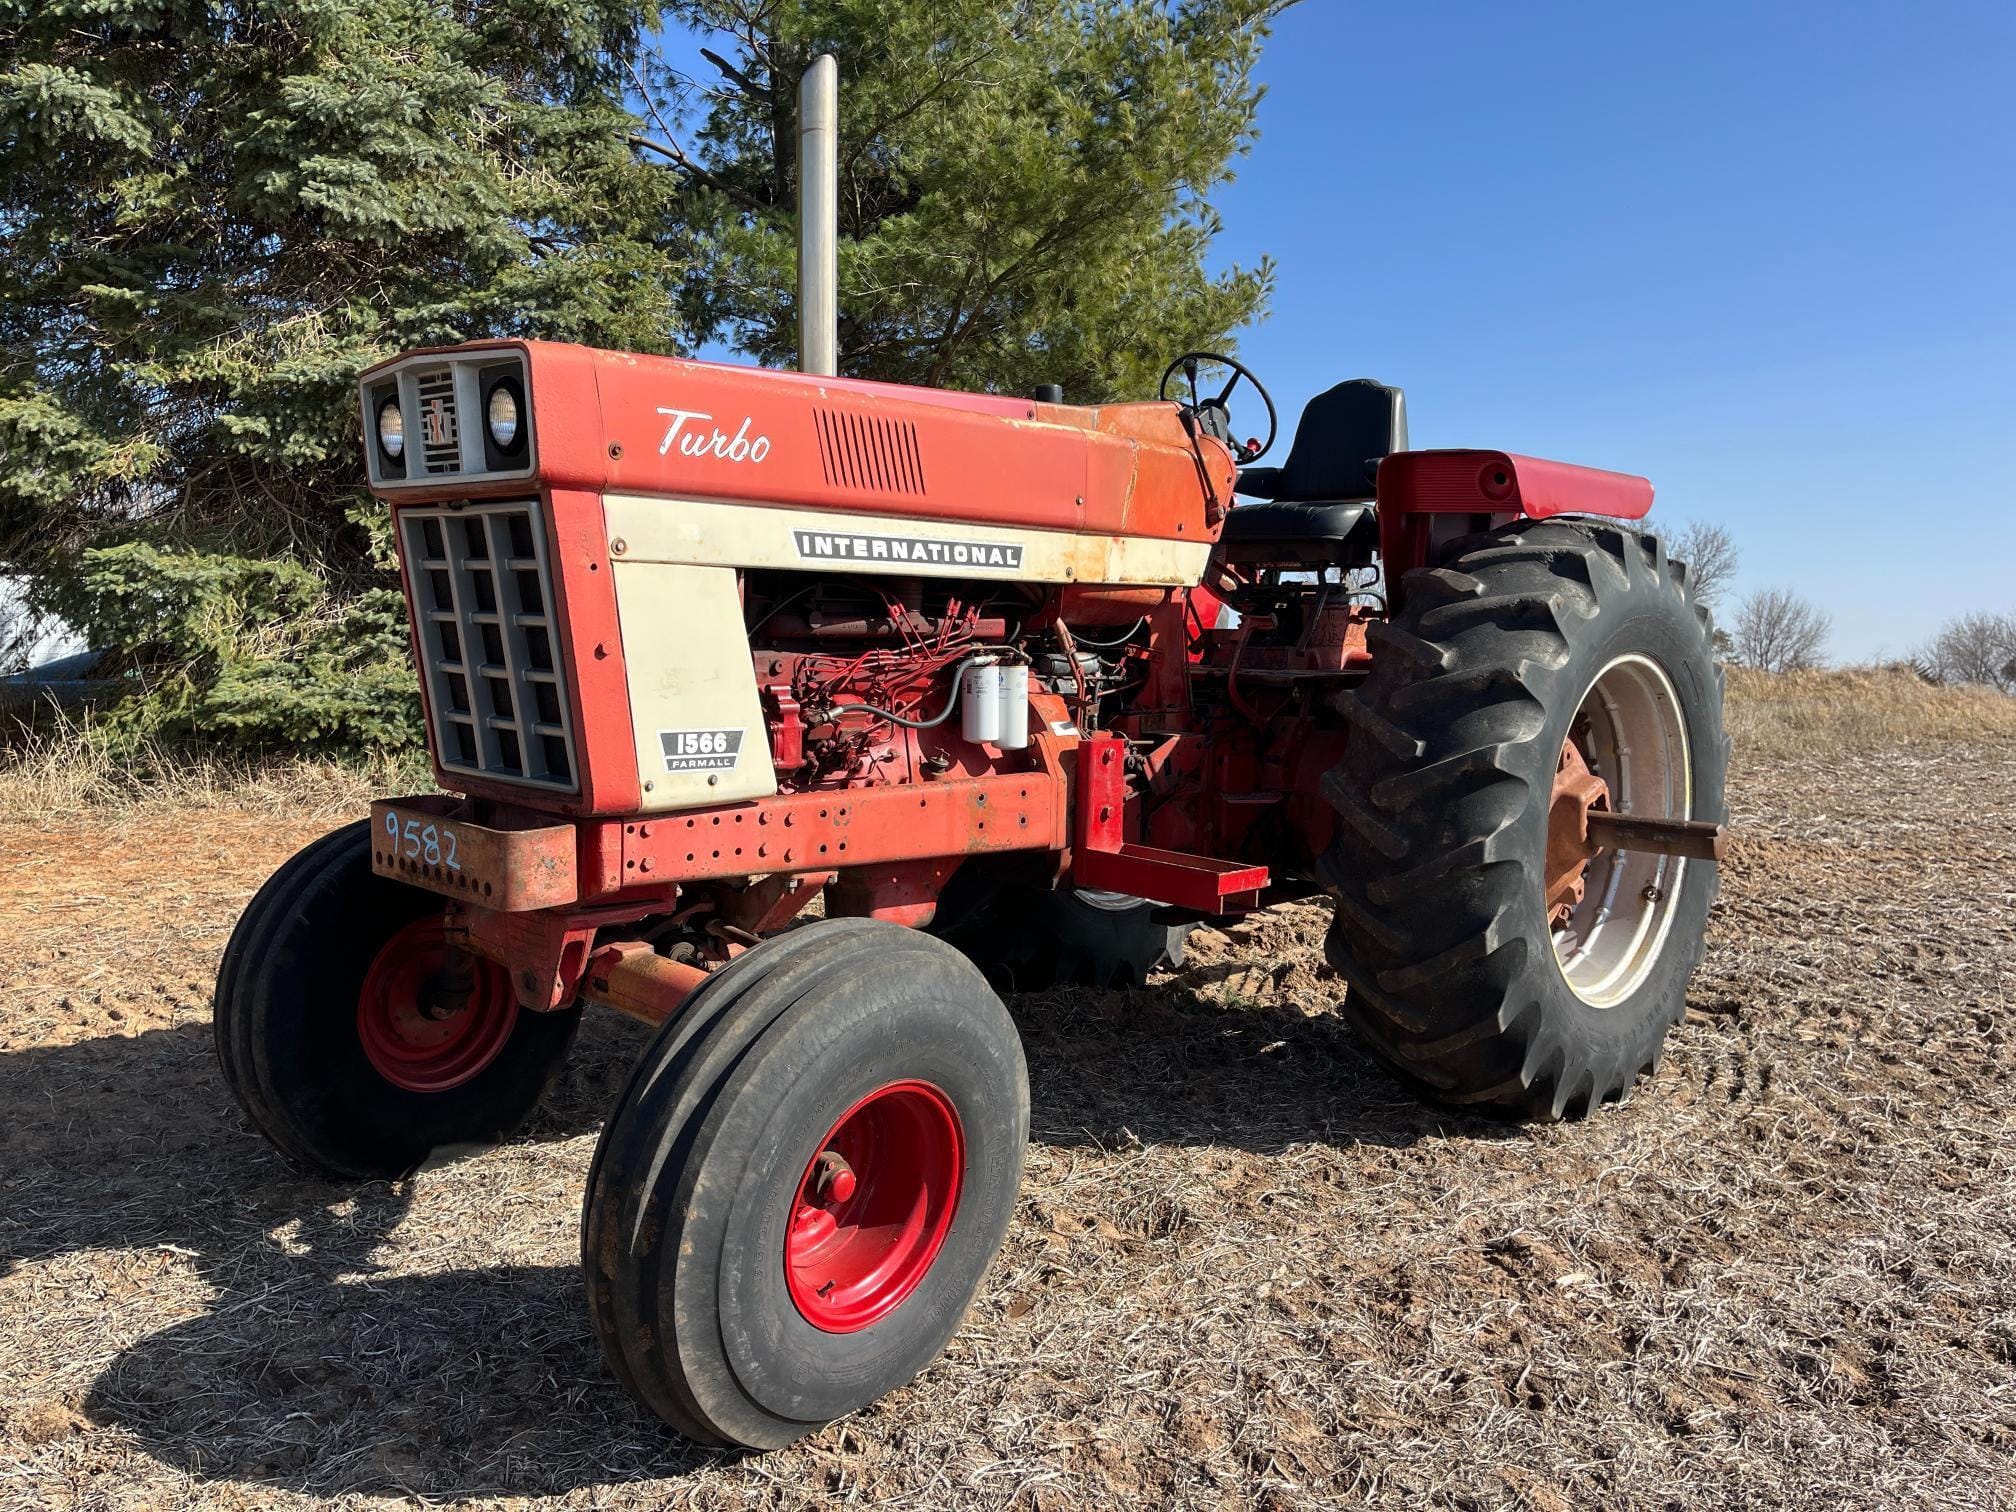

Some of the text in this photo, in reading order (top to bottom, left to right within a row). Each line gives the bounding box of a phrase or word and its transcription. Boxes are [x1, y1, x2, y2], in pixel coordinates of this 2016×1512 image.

[656, 407, 771, 463] Turbo
[802, 535, 1018, 566] INTERNATIONAL
[677, 732, 727, 754] 1566
[672, 758, 731, 769] FARMALL
[386, 811, 461, 871] 9582
